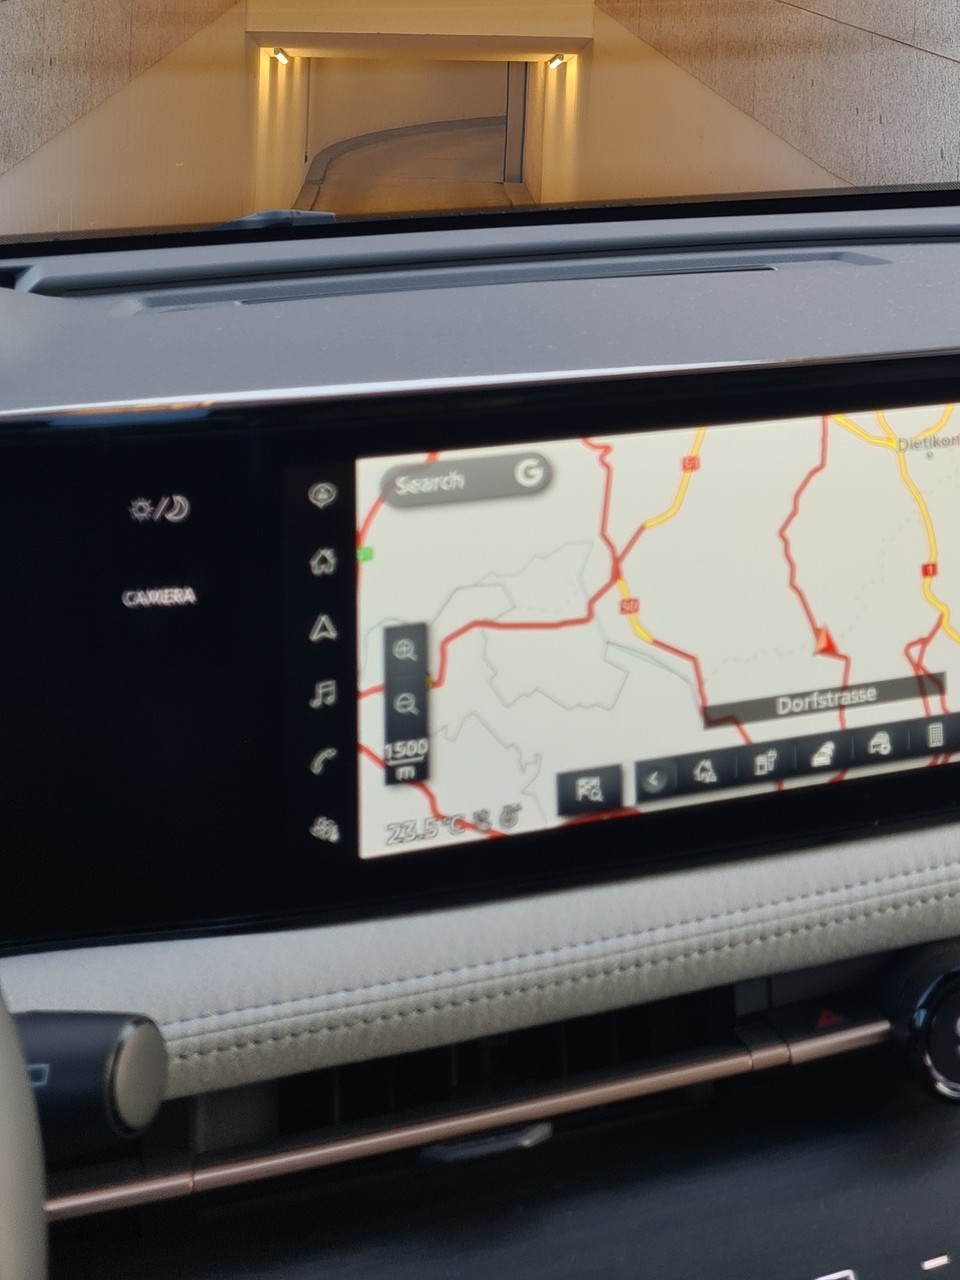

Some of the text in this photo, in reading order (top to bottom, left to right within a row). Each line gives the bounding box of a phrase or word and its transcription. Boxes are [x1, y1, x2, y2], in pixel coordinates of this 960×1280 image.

[898, 436, 960, 451] Dietikon
[395, 471, 465, 495] Search
[122, 588, 197, 608] CAMERA
[777, 686, 877, 716] Dorfstrasse
[385, 739, 428, 759] 1500
